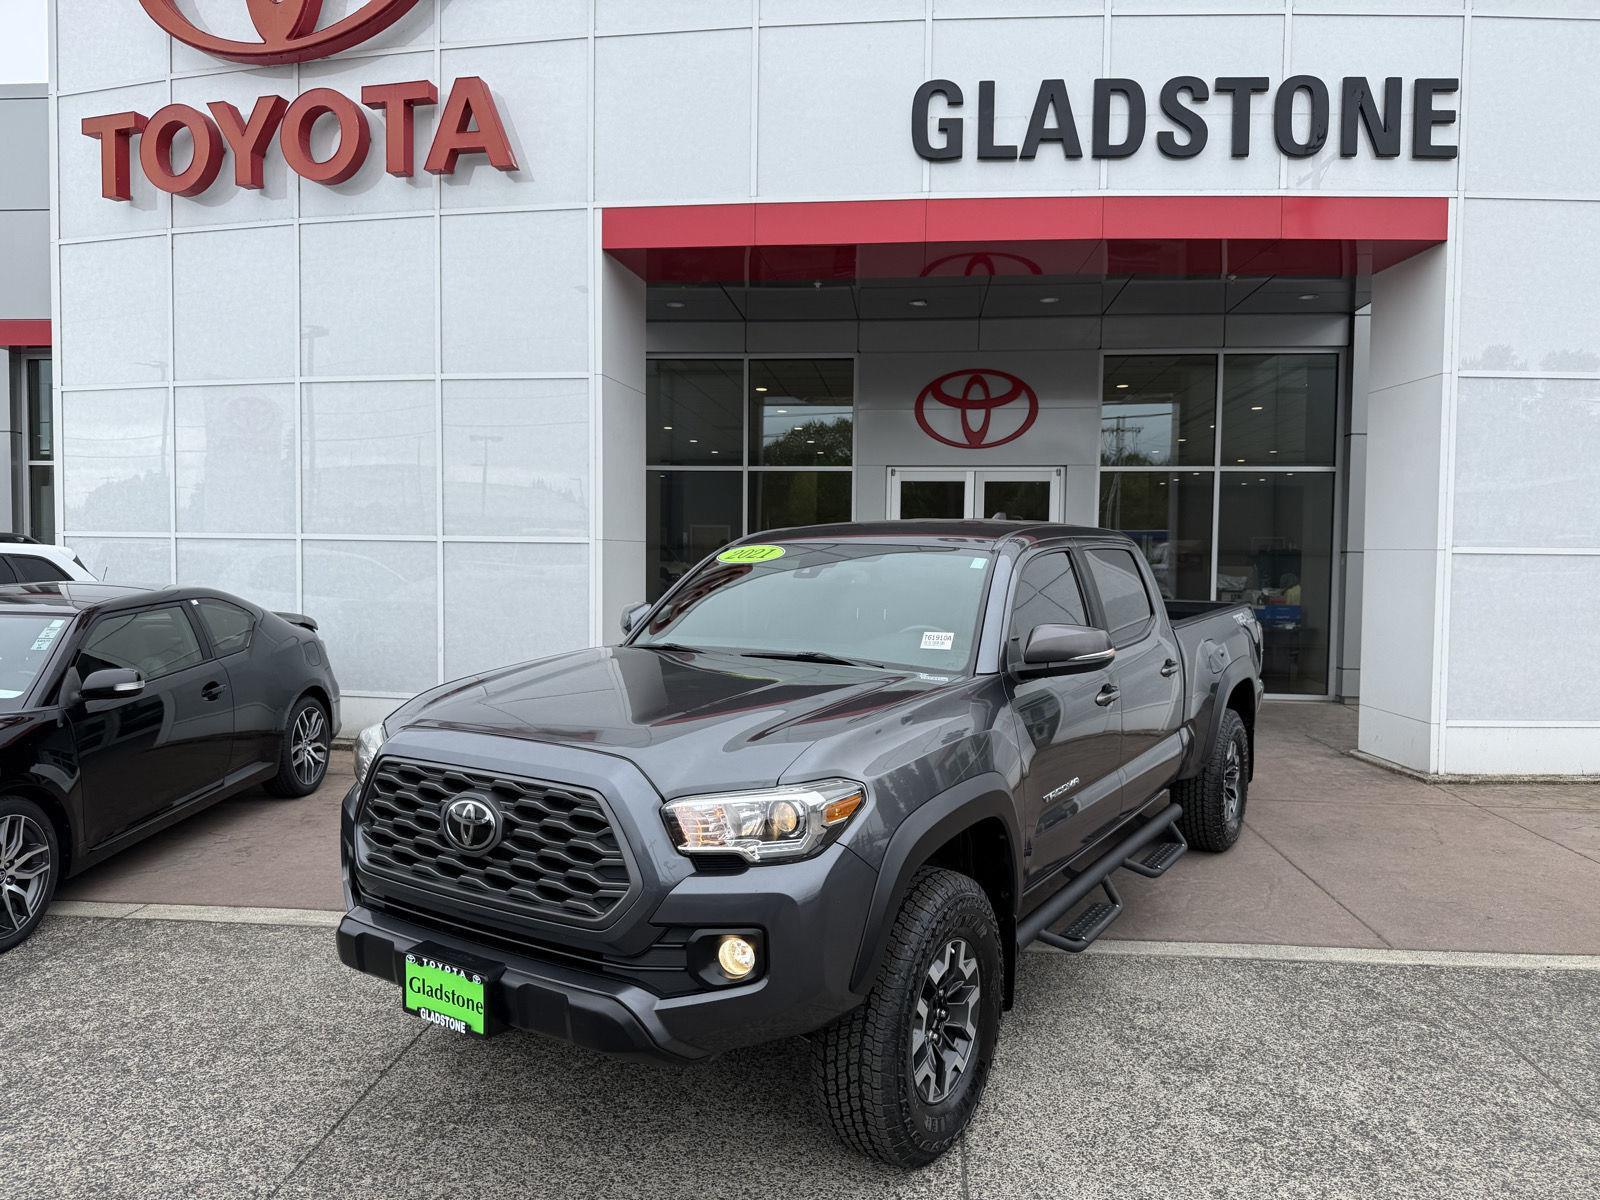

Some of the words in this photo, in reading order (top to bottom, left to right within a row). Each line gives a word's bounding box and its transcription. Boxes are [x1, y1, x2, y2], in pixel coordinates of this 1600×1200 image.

[911, 75, 1459, 160] GLADSTONE
[82, 76, 520, 201] TOYOTA
[724, 548, 777, 560] 2021
[422, 958, 466, 978] TOYOTA
[408, 976, 484, 1015] Gladstone
[420, 1007, 467, 1034] GLADSTONE
